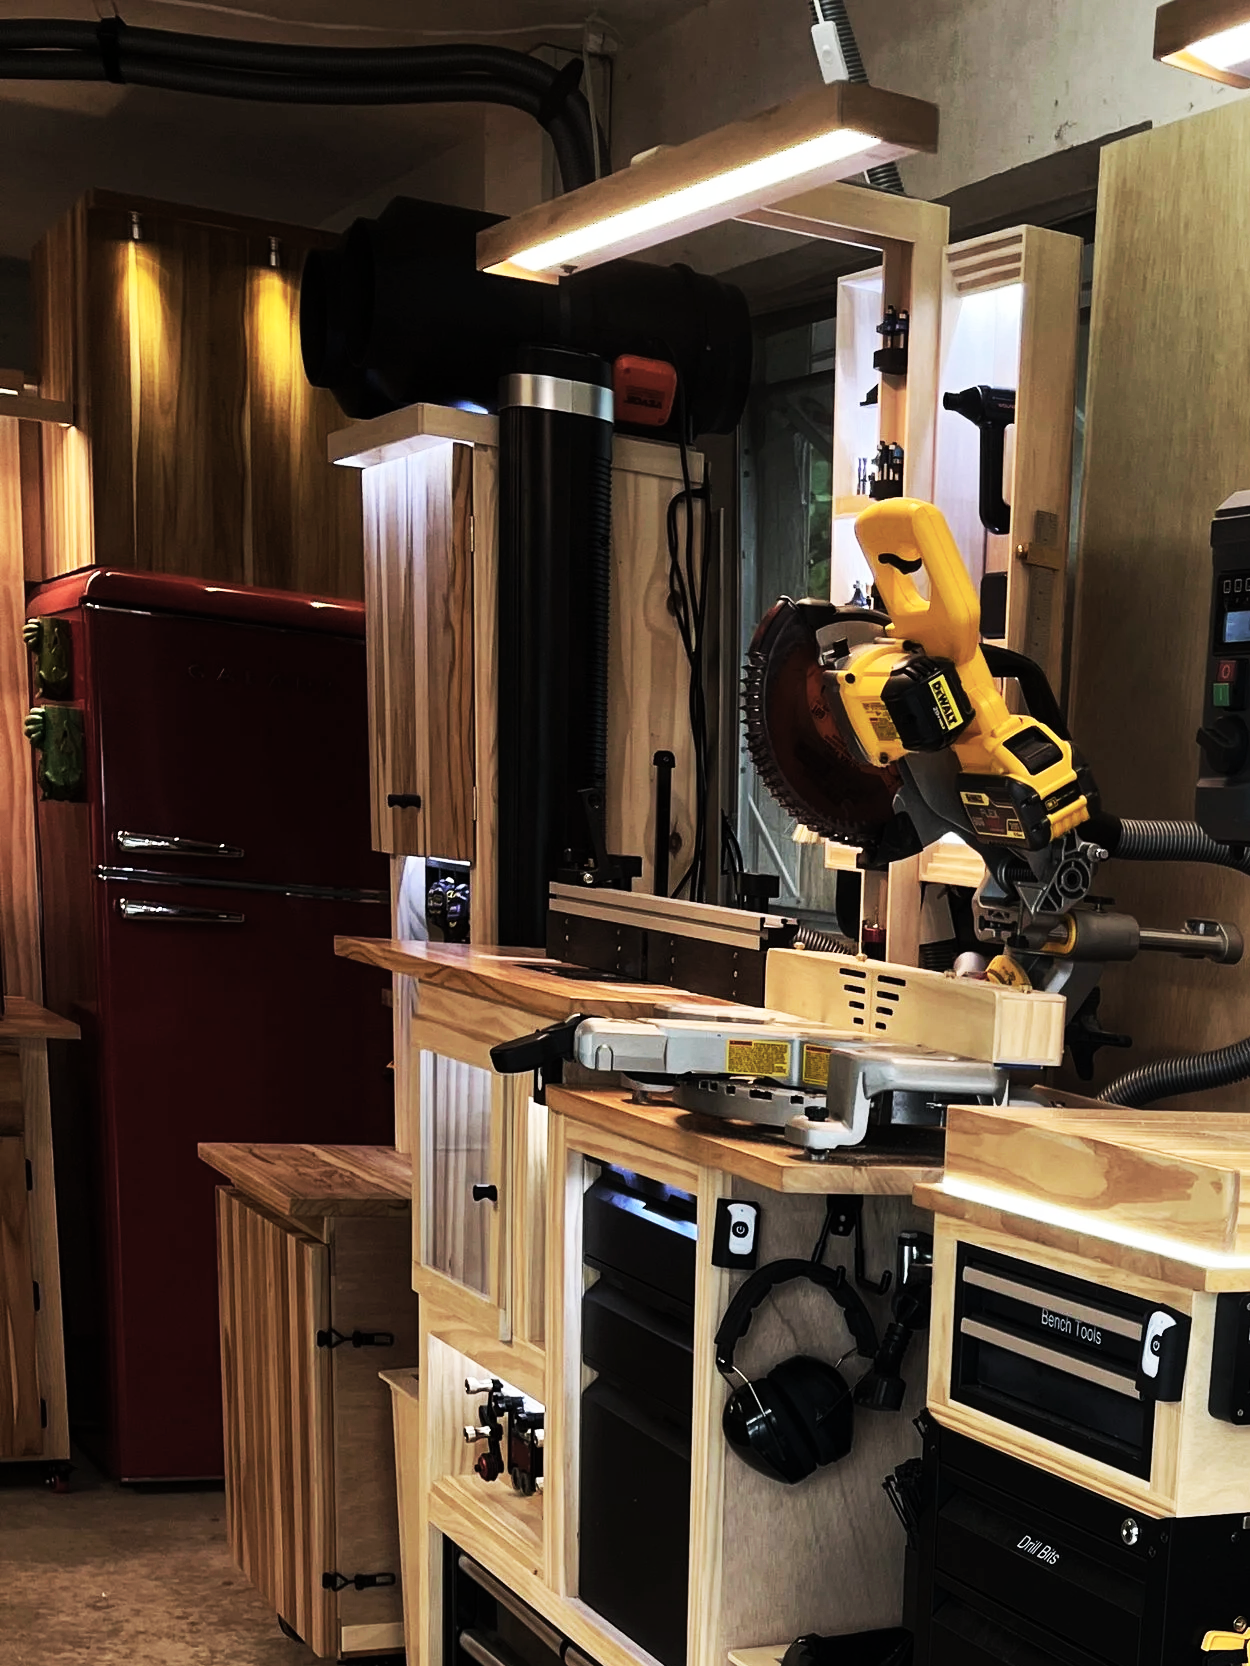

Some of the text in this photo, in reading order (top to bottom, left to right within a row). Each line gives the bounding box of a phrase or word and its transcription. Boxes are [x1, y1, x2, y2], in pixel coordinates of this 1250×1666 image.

[1041, 1307, 1102, 1345] Bench Tools
[1016, 1534, 1060, 1565] Drill Bits
